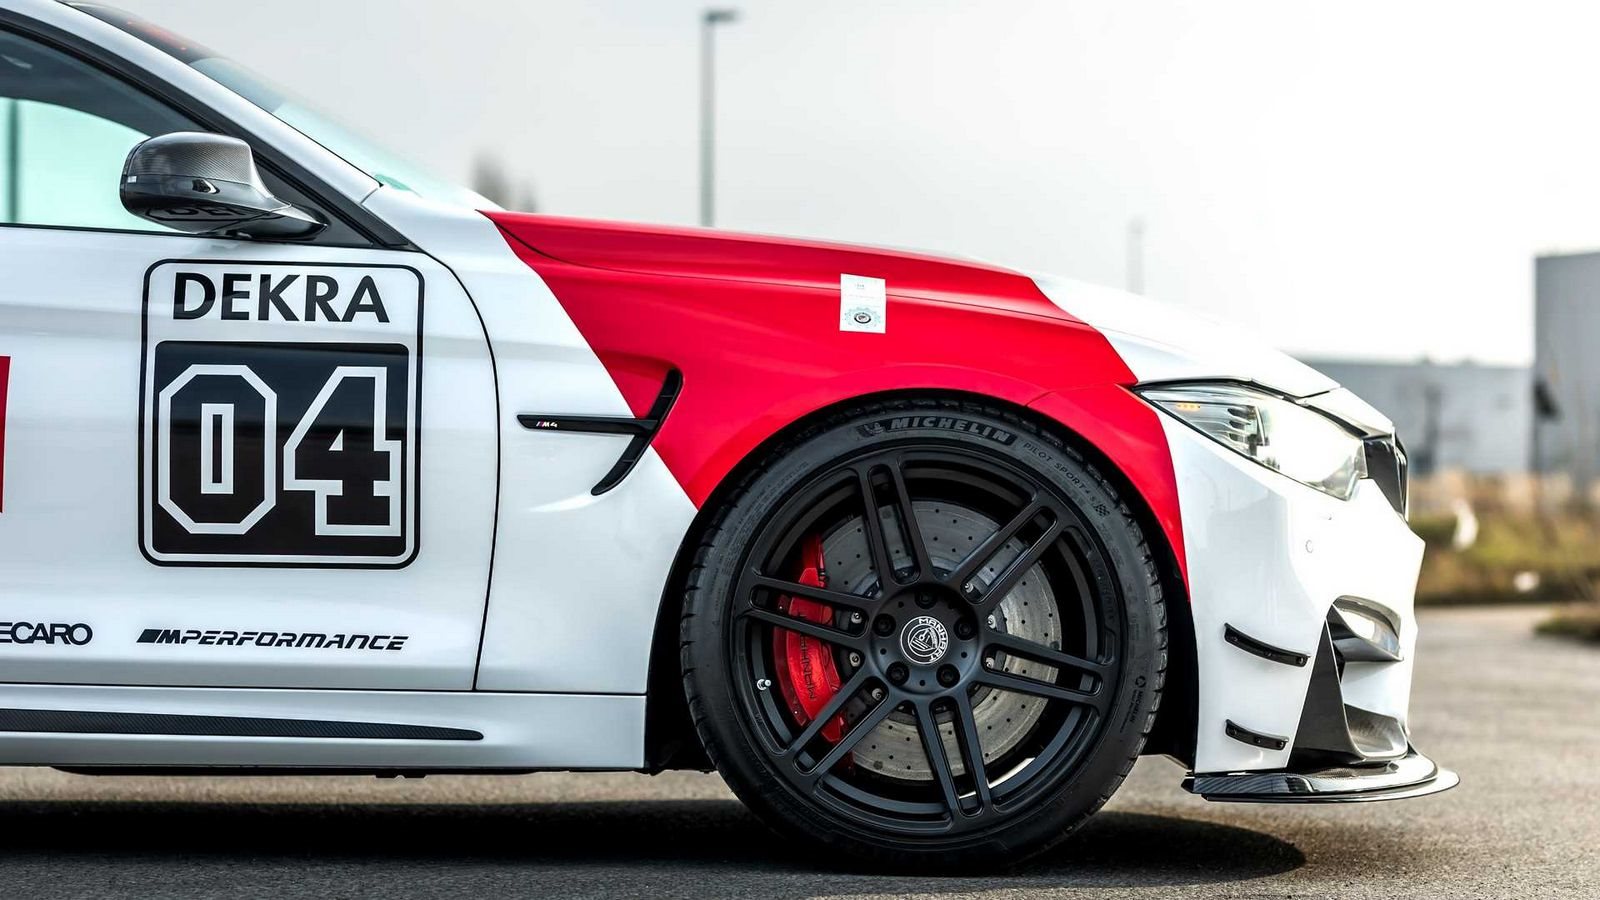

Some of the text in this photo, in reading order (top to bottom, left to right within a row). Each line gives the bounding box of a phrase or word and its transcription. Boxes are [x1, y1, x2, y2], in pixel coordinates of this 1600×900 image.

[173, 272, 390, 323] DEKRA
[158, 364, 402, 537] 04
[890, 416, 1009, 443] MICHELIN
[1023, 441, 1053, 463] PILOT
[1054, 462, 1086, 490] SPORT
[918, 617, 948, 662] MANHART
